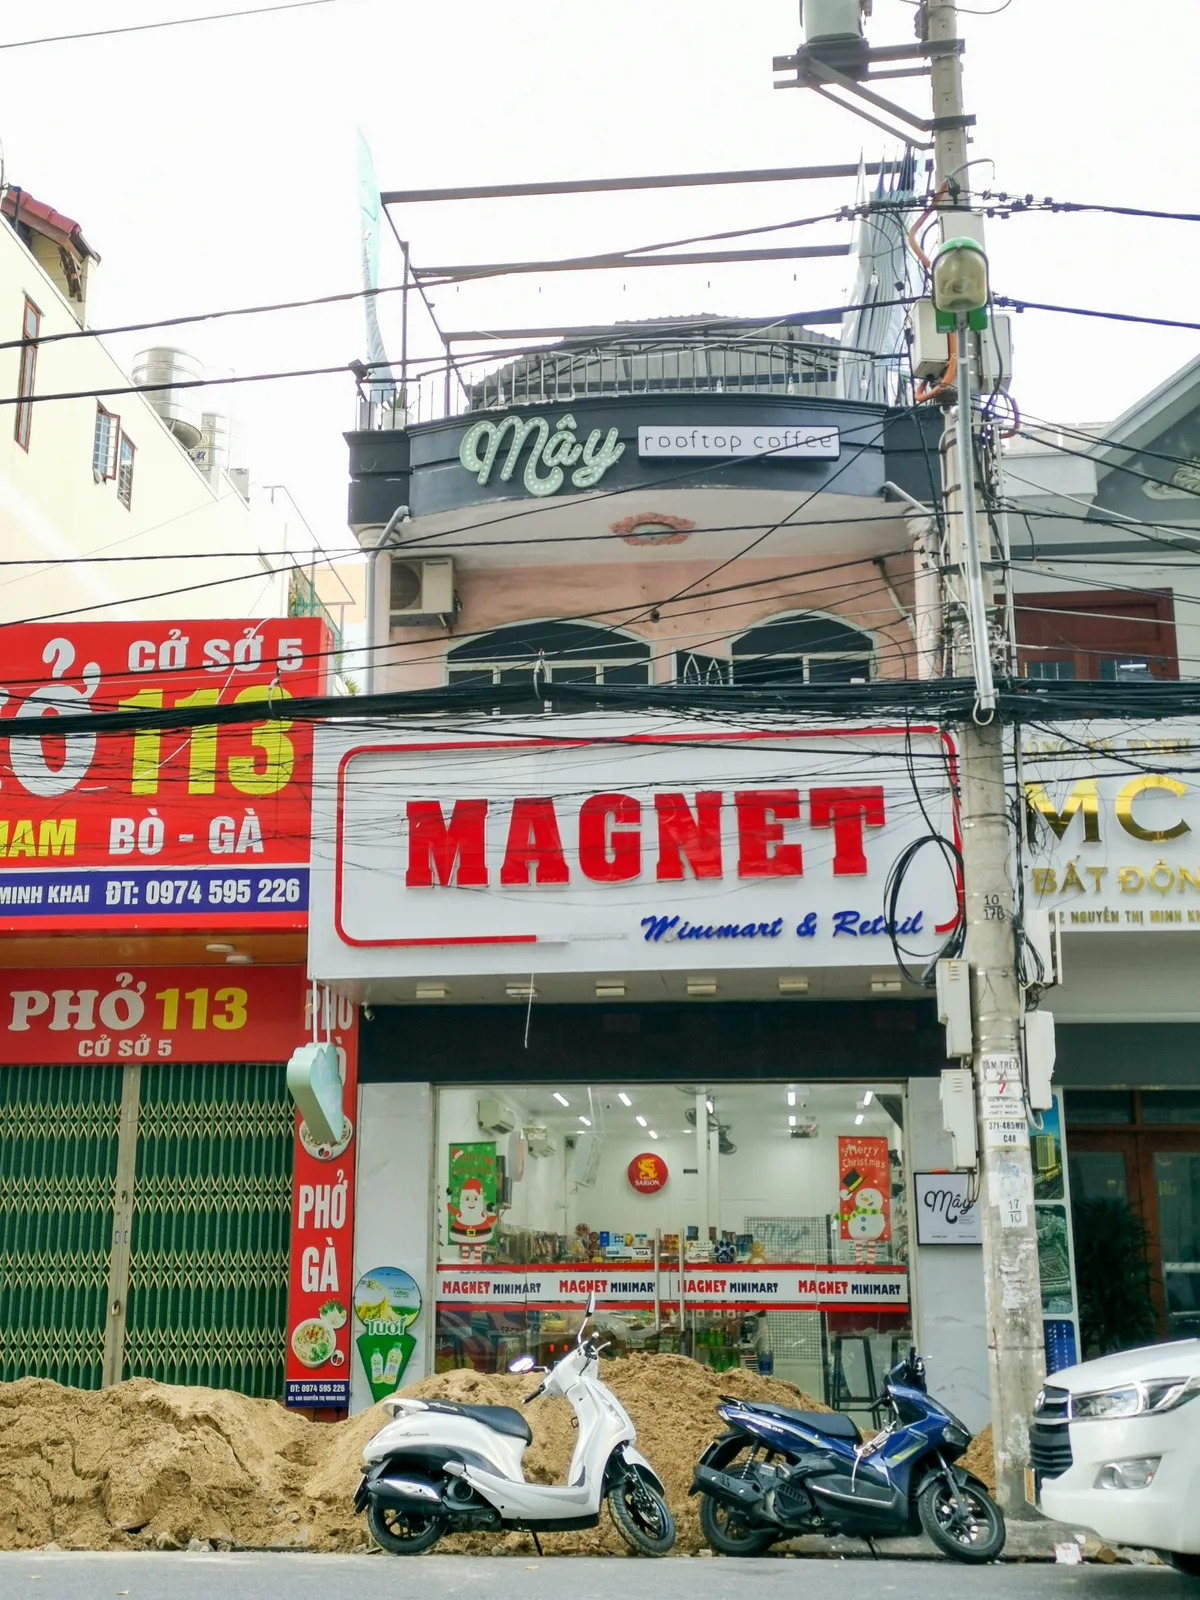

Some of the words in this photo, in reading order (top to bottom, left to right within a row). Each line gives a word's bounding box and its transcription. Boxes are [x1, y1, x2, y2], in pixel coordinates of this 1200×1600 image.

[459, 413, 626, 496] Mây
[645, 431, 742, 452] rooftop
[754, 431, 832, 449] coffee
[127, 628, 190, 672] CỞ
[202, 627, 265, 672] SỞ
[277, 638, 304, 671] 5
[118, 685, 295, 796] 113
[109, 808, 165, 856] BÒ
[208, 808, 264, 854] GÀ
[405, 785, 885, 888] MAGNET
[1032, 855, 1109, 896] BẤT
[48, 885, 90, 903] KHAI
[105, 881, 139, 905] ĐT:
[146, 880, 201, 904] 0974
[208, 879, 251, 903] 595
[257, 878, 301, 903] 226
[984, 893, 1000, 906] 10
[796, 911, 818, 937] &
[1125, 910, 1144, 926] THỊ
[1150, 910, 1182, 924] MINH
[7, 972, 147, 1031] PHỞ
[155, 987, 248, 1030] 113
[78, 1034, 111, 1057] CỞ
[118, 1033, 152, 1057] SỞ
[158, 1039, 172, 1057] 5
[298, 1169, 348, 1229] PHỞ
[924, 1190, 974, 1224] Mây
[301, 1238, 339, 1293] GÀ
[442, 1281, 490, 1295] MAGNET
[493, 1282, 541, 1295] MINIMART
[559, 1280, 608, 1293] MAGNET
[610, 1282, 656, 1293] MINIMAR
[730, 1282, 778, 1293] MINIMART
[798, 1280, 848, 1294] MAGNET
[851, 1283, 901, 1295] MINIMART
[301, 1384, 318, 1393] 0974
[319, 1384, 331, 1393] 595
[332, 1384, 346, 1393] 226
